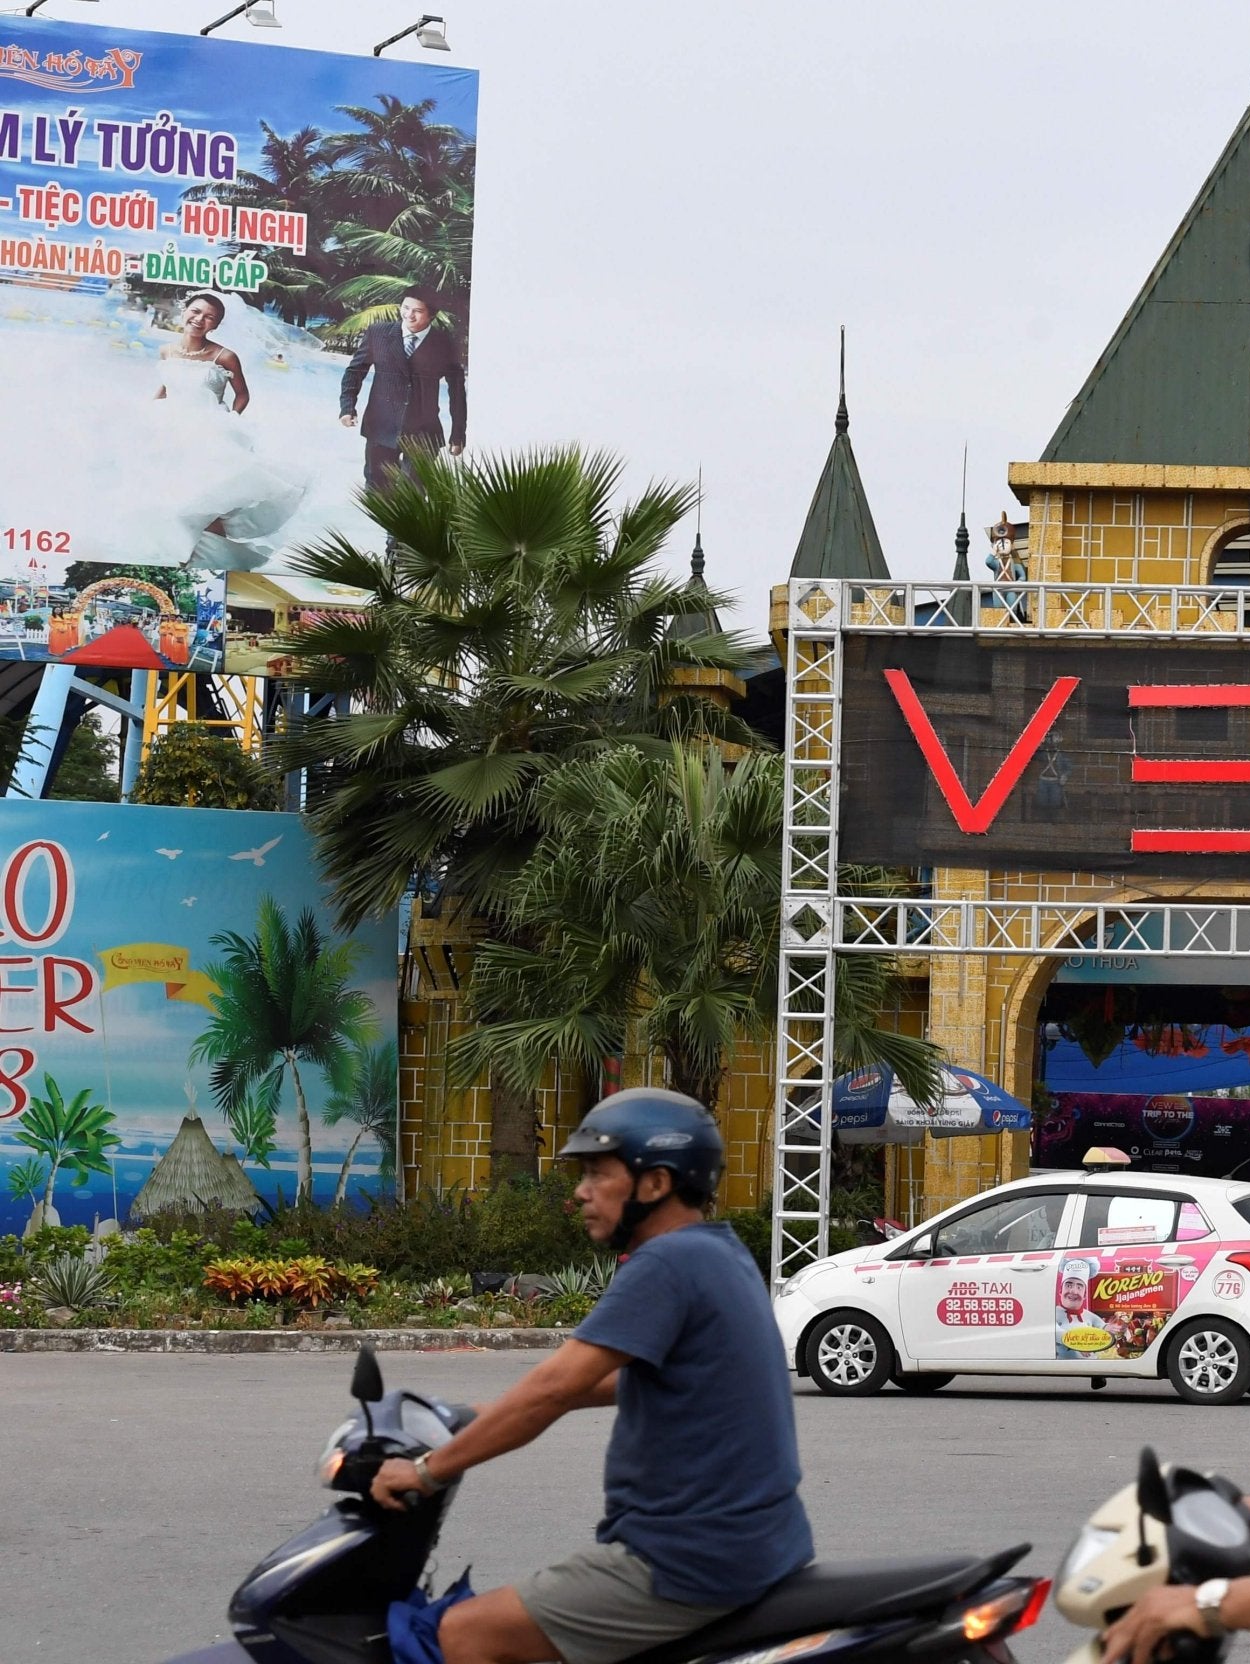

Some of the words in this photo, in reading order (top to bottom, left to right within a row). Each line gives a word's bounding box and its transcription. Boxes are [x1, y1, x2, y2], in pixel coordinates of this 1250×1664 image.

[36, 110, 84, 164] LÝ
[97, 113, 236, 180] TƯỞNG
[19, 184, 81, 228] TIỆC
[90, 192, 155, 230] CƯỚI
[184, 203, 229, 243] HỘI
[239, 210, 305, 252] NGHỊ
[1, 237, 67, 270] HOÀN
[74, 240, 122, 275] HẢO
[145, 242, 211, 285] ĐẲNG
[218, 252, 266, 289] CẤP
[3, 527, 71, 553] 1162
[840, 1113, 868, 1125] pepsi
[1001, 1113, 1019, 1123] pepsi
[1142, 1110, 1162, 1118] TRIP
[1163, 1110, 1175, 1119] TO
[1177, 1111, 1194, 1119] THE
[981, 1282, 1012, 1294] TAXI
[1092, 1270, 1164, 1300] KORENO
[1217, 1282, 1241, 1295] 776
[945, 1299, 1014, 1312] 32.58.58.58
[945, 1313, 1014, 1325] 32.19.19.19
